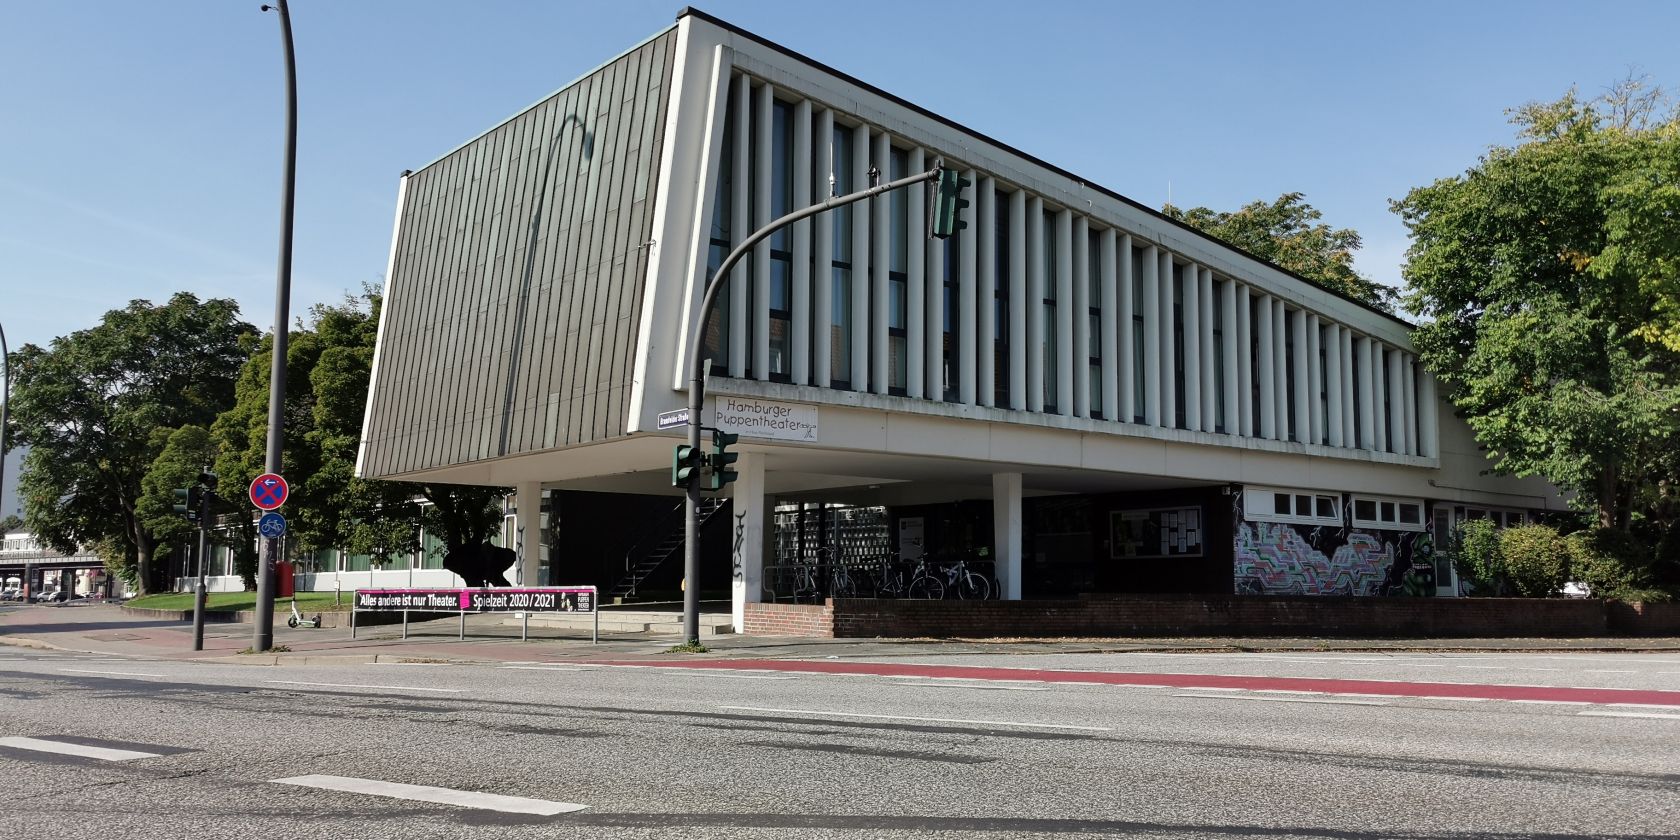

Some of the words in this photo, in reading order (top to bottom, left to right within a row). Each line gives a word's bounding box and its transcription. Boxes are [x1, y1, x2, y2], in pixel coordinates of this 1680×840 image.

[727, 399, 792, 418] Hamburger
[716, 411, 801, 431] Puppentheater
[360, 593, 377, 606] Alles
[378, 593, 401, 606] andere
[402, 593, 412, 606] ist
[413, 596, 427, 606] nur
[428, 593, 457, 607] Theater.
[473, 593, 508, 610] Spielzeit
